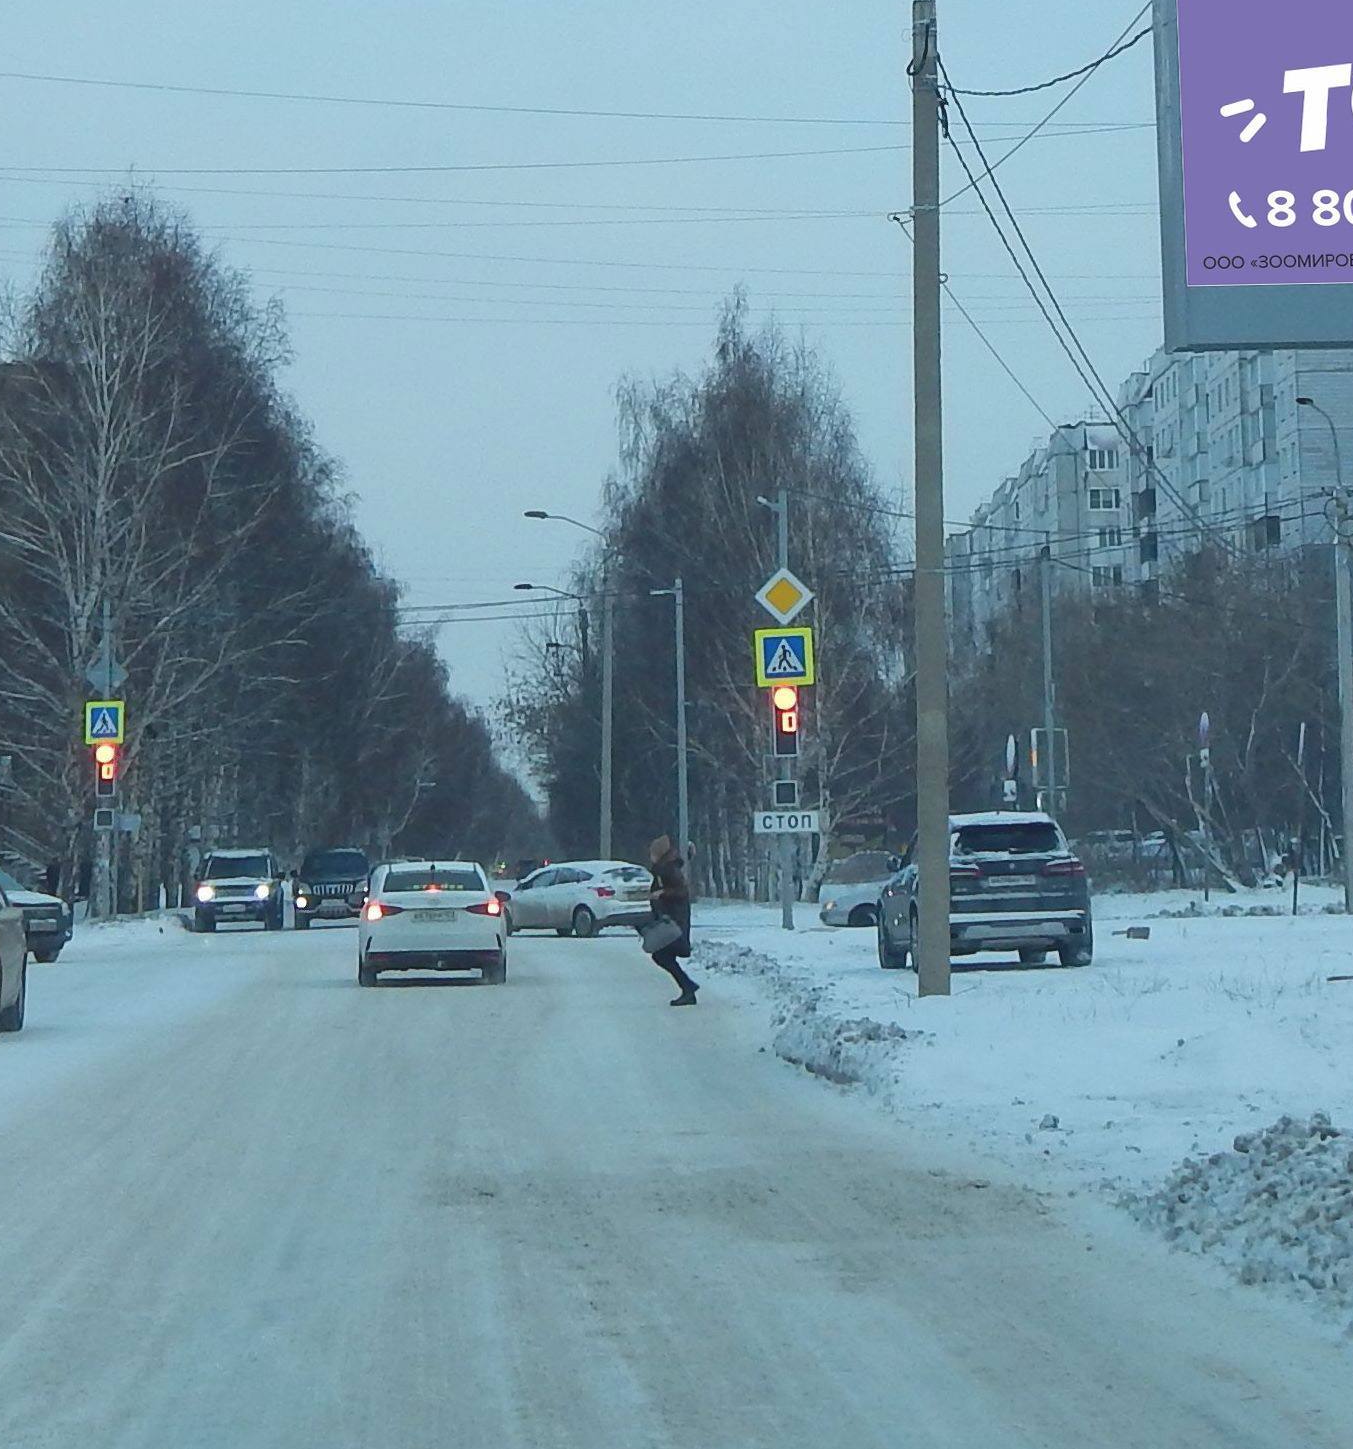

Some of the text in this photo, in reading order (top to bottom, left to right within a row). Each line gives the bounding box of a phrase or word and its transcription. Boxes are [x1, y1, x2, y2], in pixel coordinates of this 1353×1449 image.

[1266, 189, 1297, 228] 8
[1202, 255, 1245, 270] ООО
[762, 814, 812, 830] СТОП
